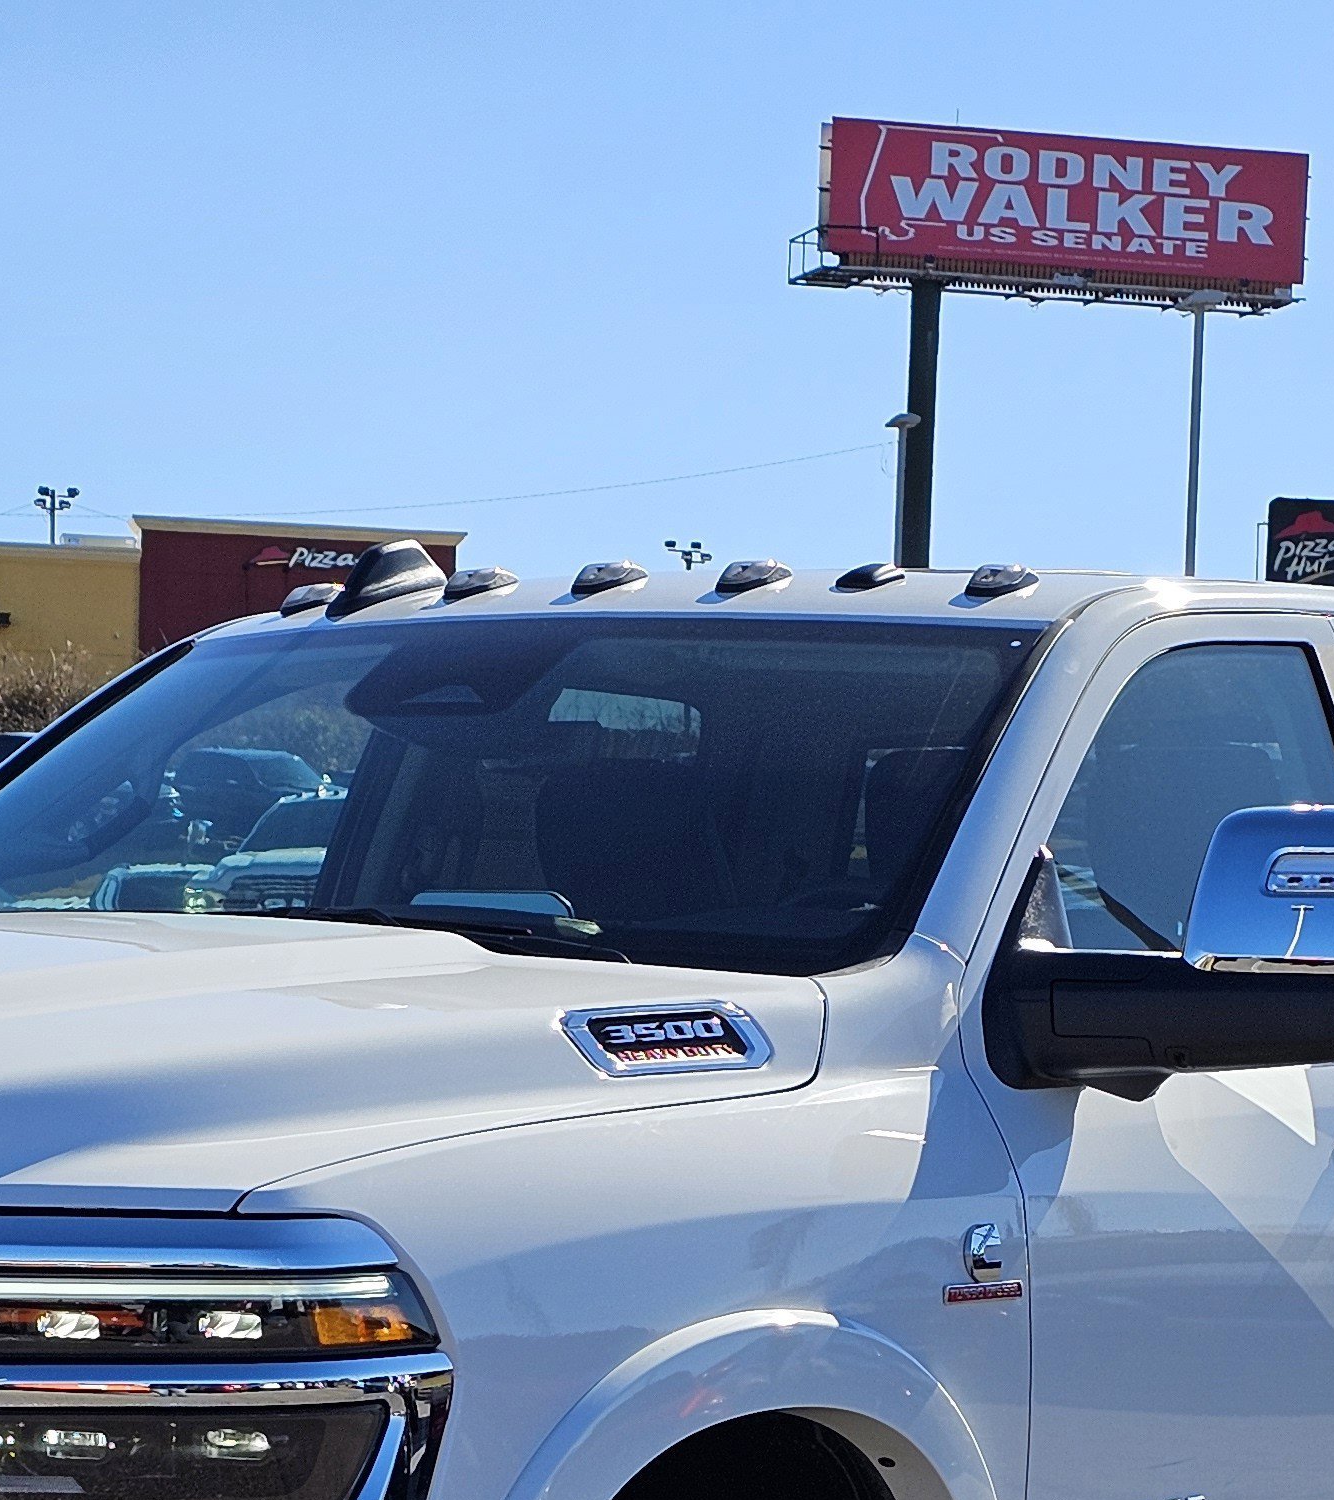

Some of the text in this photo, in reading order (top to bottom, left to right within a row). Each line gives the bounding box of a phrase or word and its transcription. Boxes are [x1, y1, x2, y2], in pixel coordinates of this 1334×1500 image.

[930, 141, 1243, 198] RODNEY
[889, 174, 1274, 246] WALKER
[956, 224, 1017, 244] US
[1031, 230, 1209, 258] SENATE
[288, 547, 357, 568] Pizza
[1285, 554, 1334, 580] Hut
[602, 1019, 724, 1044] 3500
